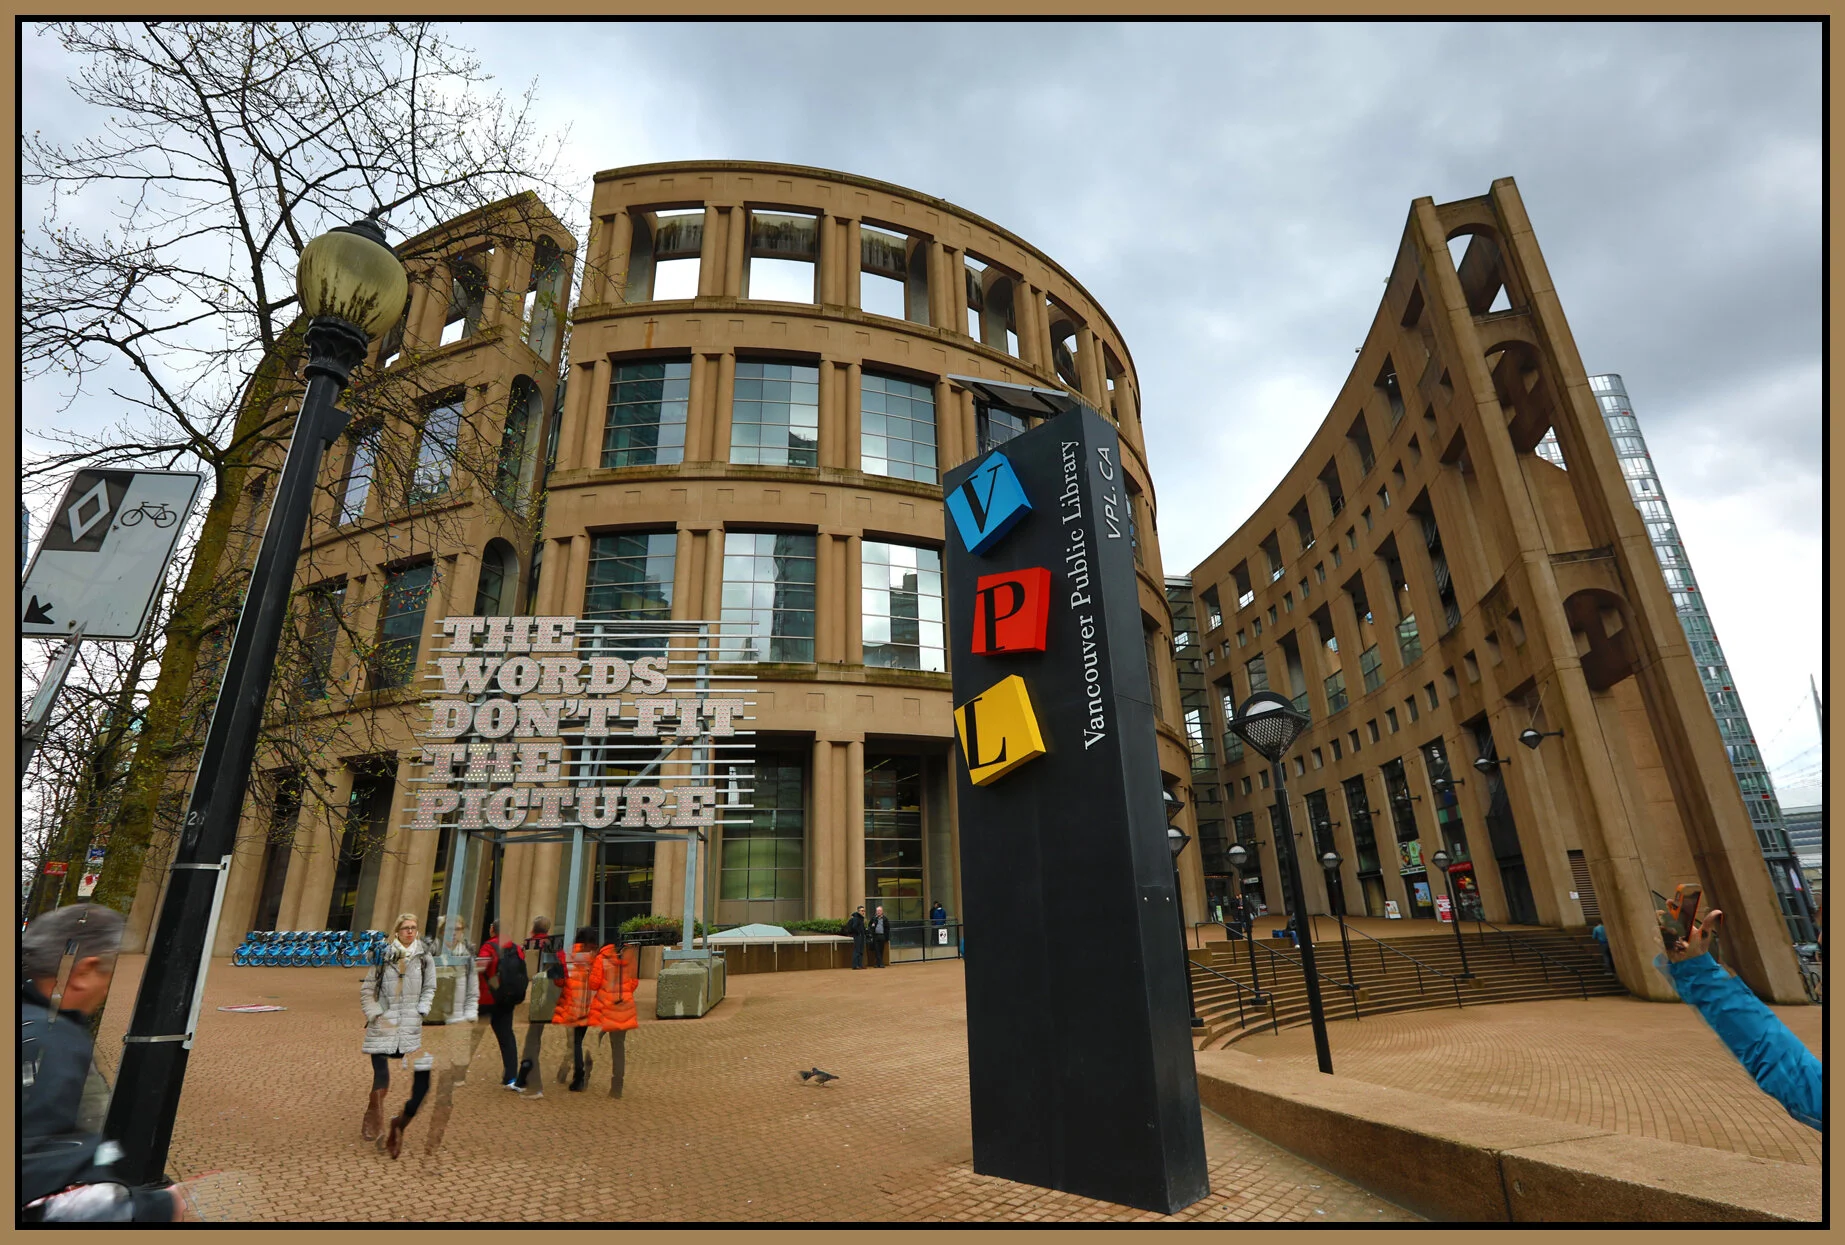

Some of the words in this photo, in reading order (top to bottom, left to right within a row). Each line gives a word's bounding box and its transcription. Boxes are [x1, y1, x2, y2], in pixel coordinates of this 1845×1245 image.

[960, 463, 1004, 534] V
[1059, 441, 1083, 525] Library
[1067, 528, 1091, 610] Public
[443, 616, 577, 653] THE
[976, 581, 1026, 650] P
[438, 656, 668, 695] WORDS
[1079, 615, 1106, 750] Vancouver
[425, 698, 621, 738] DON'T
[632, 698, 744, 738] FIT
[963, 696, 1008, 771] L
[422, 742, 563, 783] THE
[411, 786, 717, 830] PICTURE
